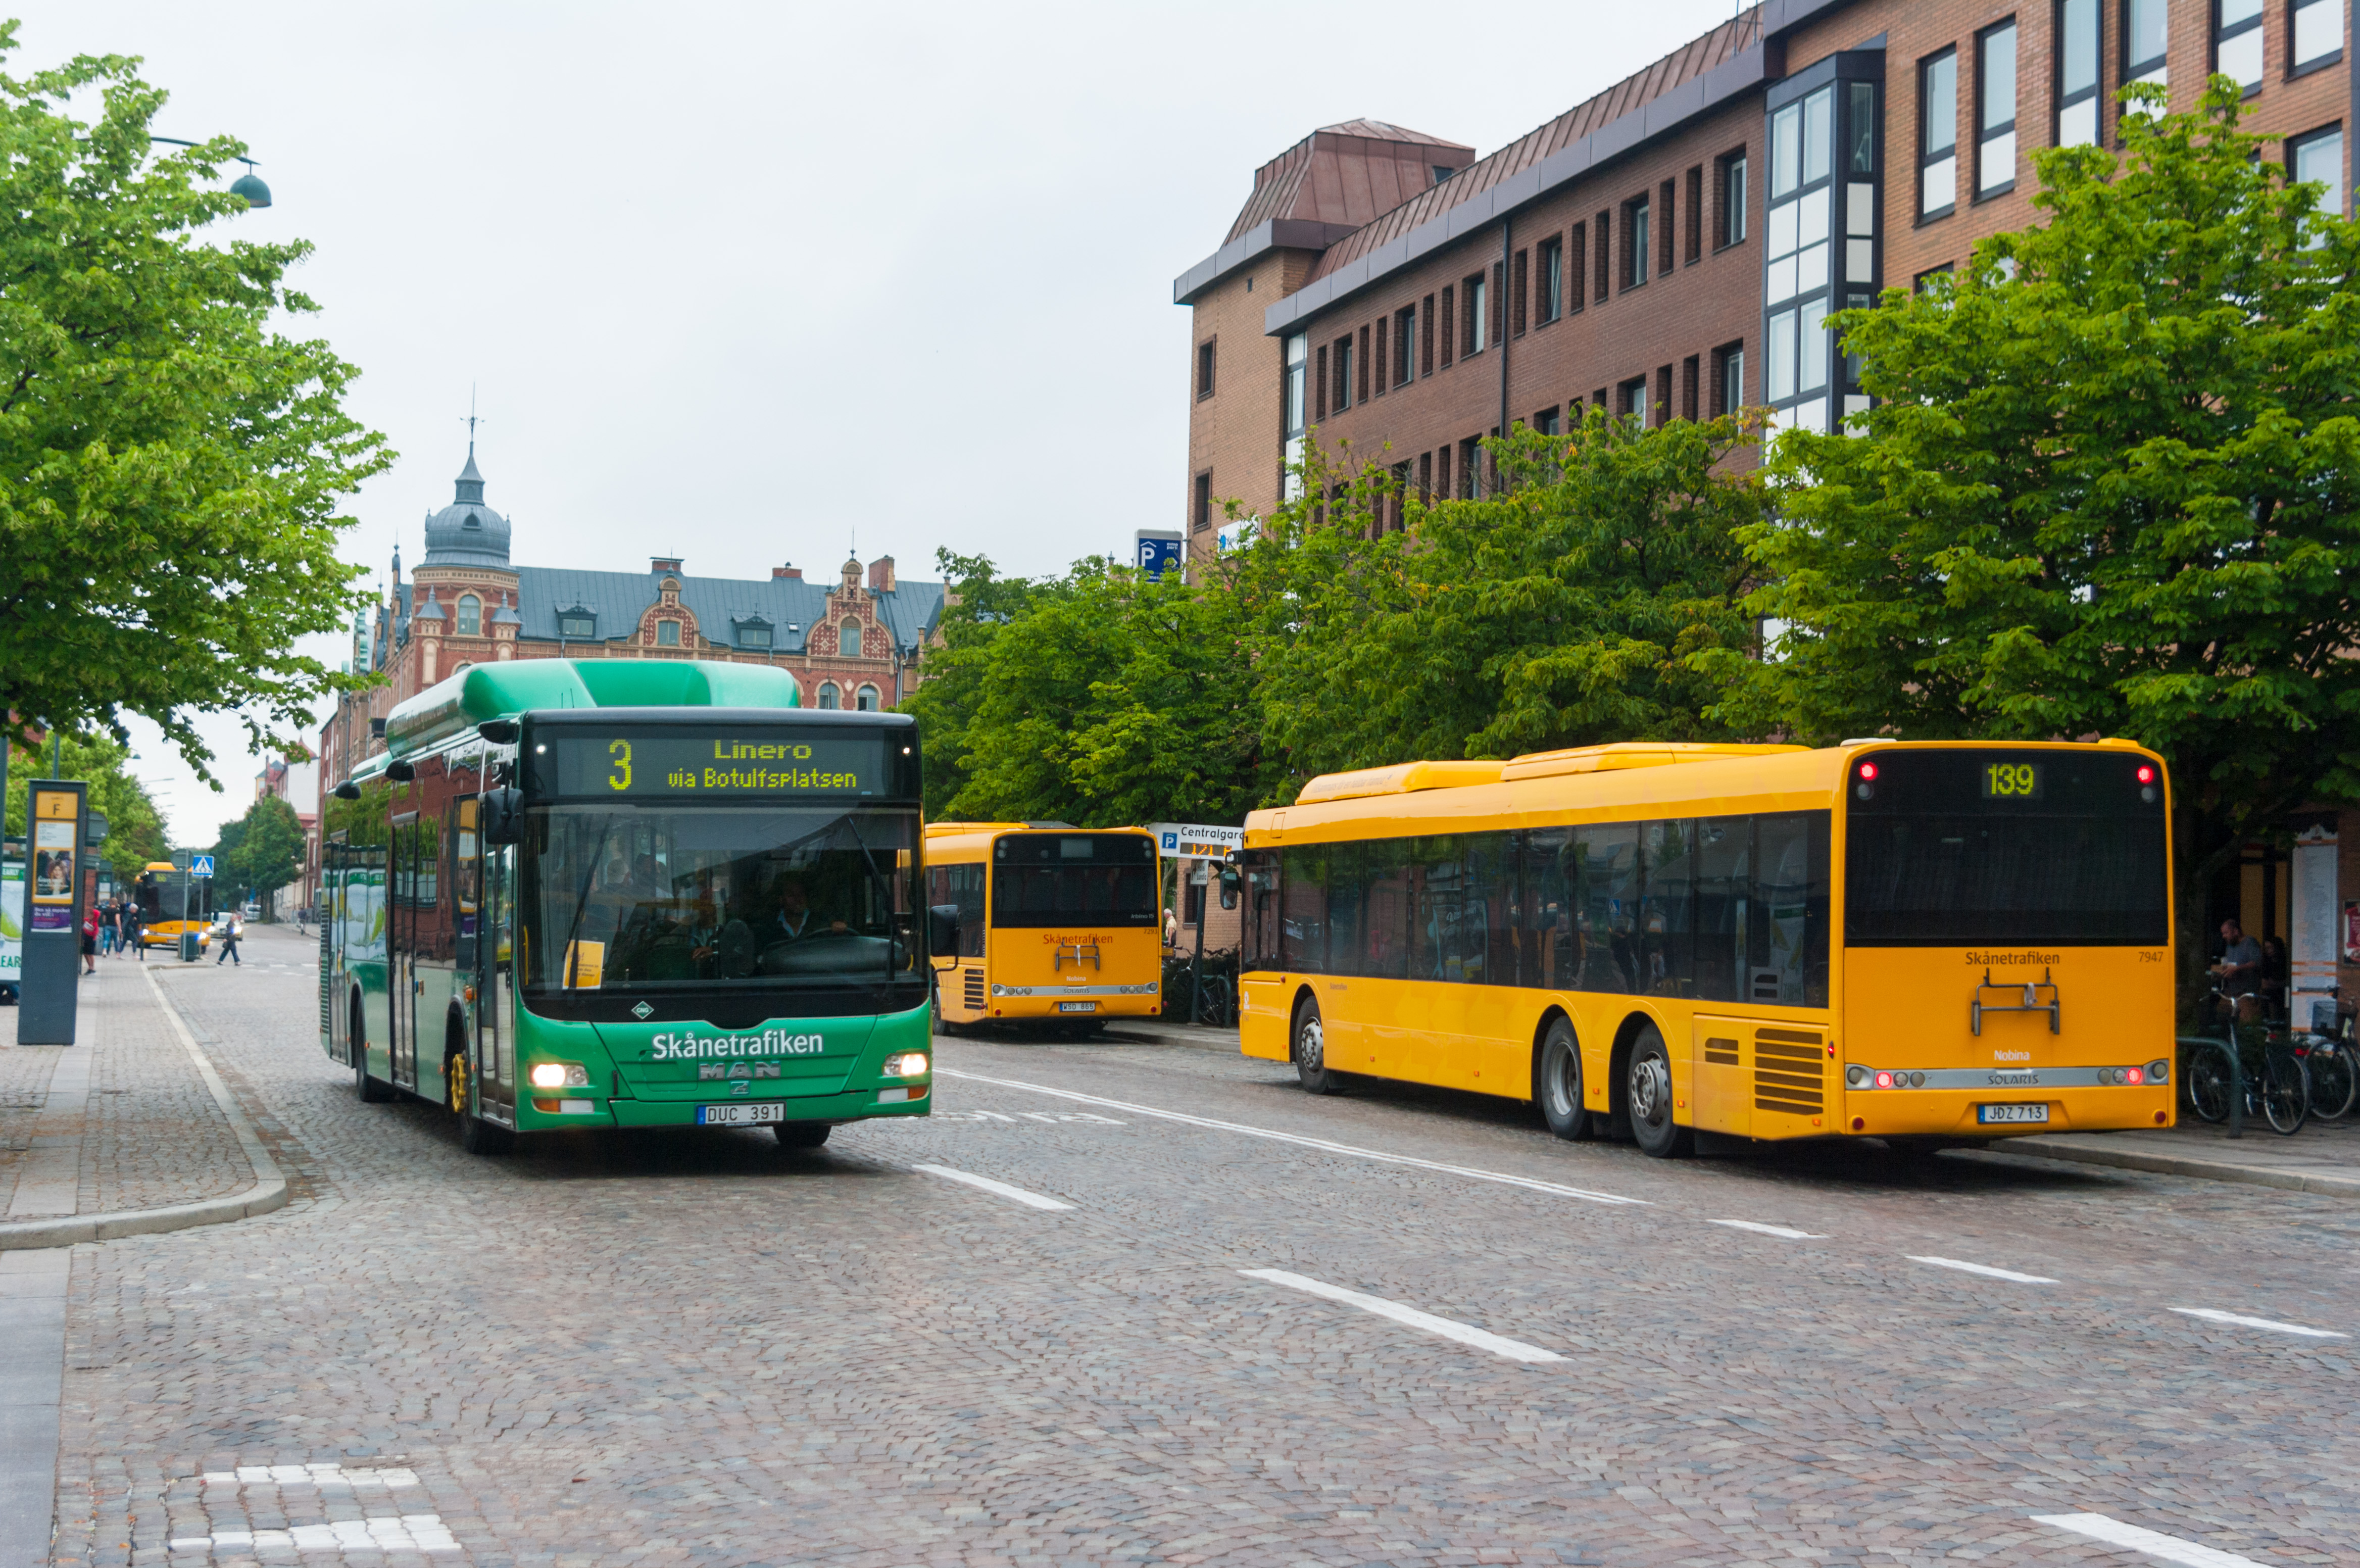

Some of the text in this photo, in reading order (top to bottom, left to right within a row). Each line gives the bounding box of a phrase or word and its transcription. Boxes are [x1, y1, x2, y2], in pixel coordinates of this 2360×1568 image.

[1141, 547, 1155, 567] P
[715, 740, 812, 759] Linero
[609, 739, 631, 790] 3
[668, 768, 857, 788] via Botulfsplatsen
[1988, 764, 2034, 795] 139
[53, 804, 61, 815] F
[1165, 837, 1174, 848] P
[1191, 844, 1213, 856] 171
[1043, 934, 1113, 944] Skånetrafiken
[0, 955, 22, 968] EAR
[1965, 951, 2060, 965] Skånetrafiken
[2138, 952, 2164, 962] 7947
[652, 1029, 823, 1059] Skånetrafiken
[1994, 1049, 2030, 1061] Nobina
[699, 1061, 781, 1081] MAN
[1988, 1074, 2039, 1085] SOLARIS
[708, 1106, 779, 1122] DUC 391
[1990, 1106, 2042, 1119] JDZ 713
